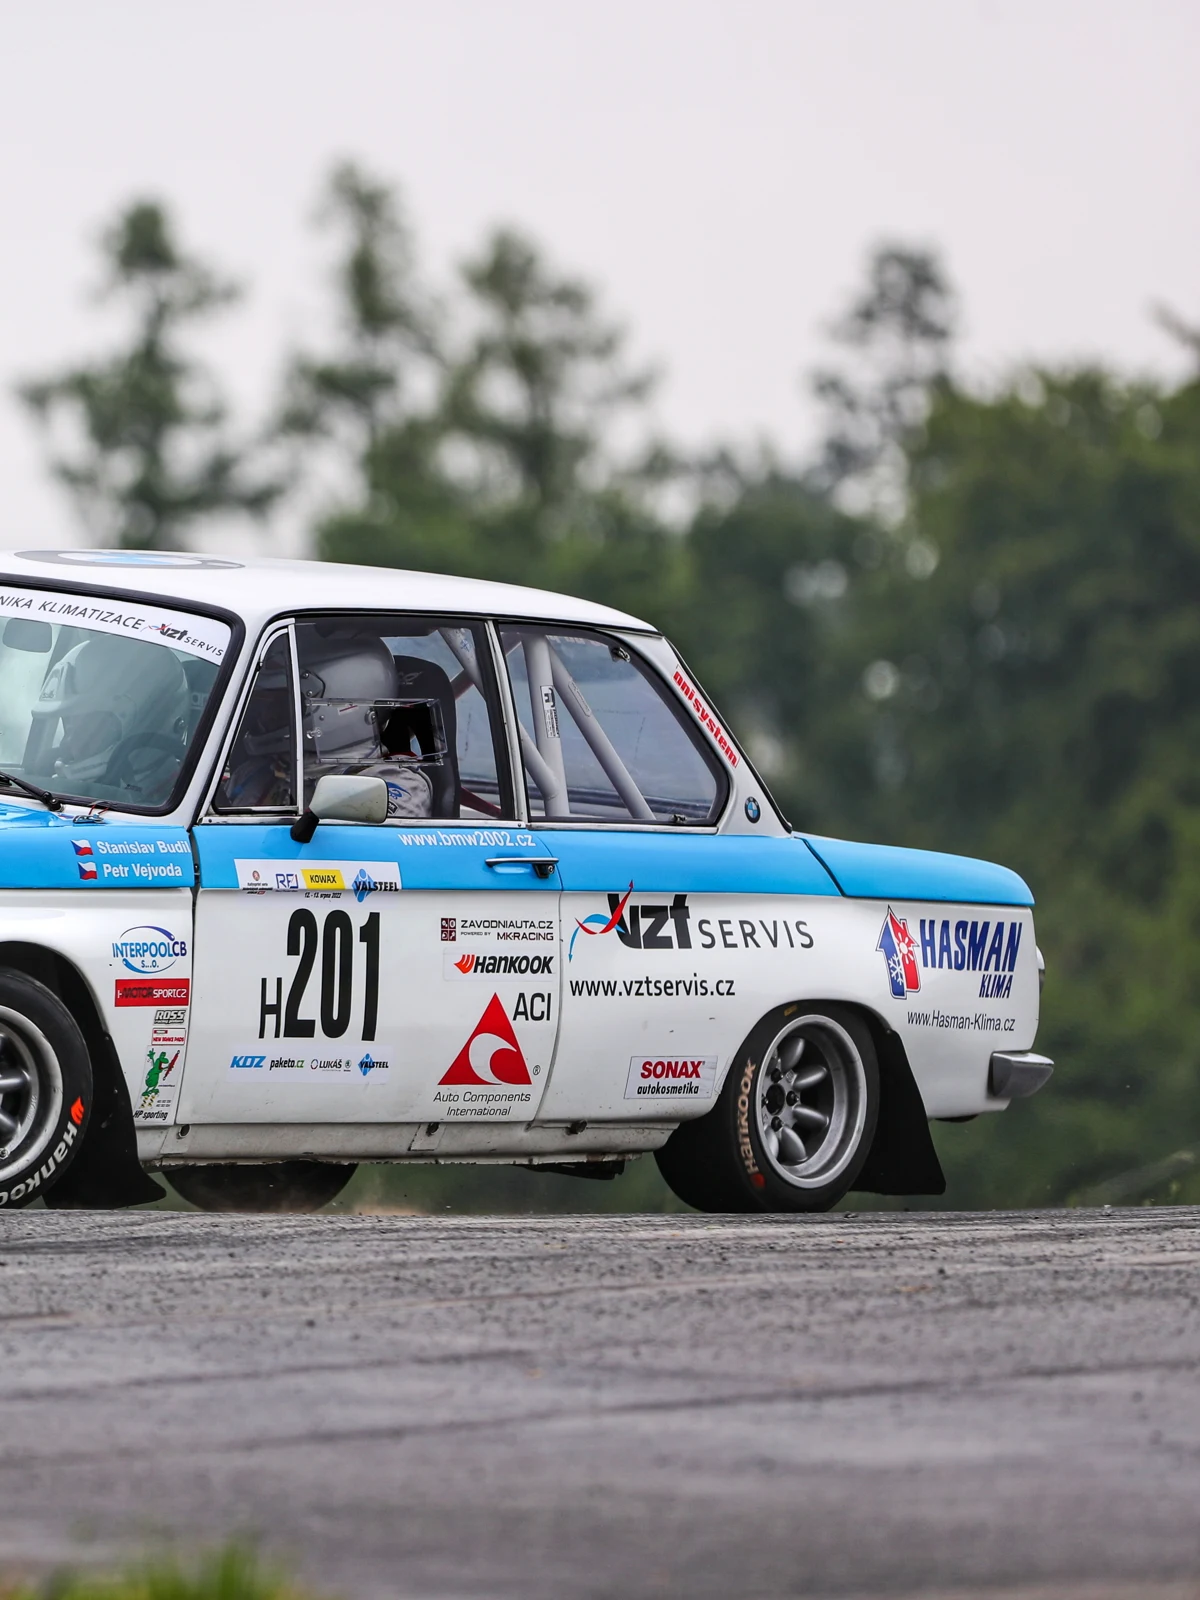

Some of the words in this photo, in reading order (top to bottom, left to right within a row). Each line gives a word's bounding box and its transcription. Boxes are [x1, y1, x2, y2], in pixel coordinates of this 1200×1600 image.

[38, 601, 146, 630] KLIMATIZACE
[184, 636, 225, 657] SERVIS
[398, 831, 536, 847] www.bmw2002.cz
[96, 840, 155, 855] Stanislav
[103, 863, 129, 877] Petr
[131, 863, 183, 880] Vejvoda
[309, 874, 337, 884] KOWAX
[354, 880, 400, 892] VALSTEEL
[460, 919, 554, 929] ZAVODNIAUTA.CZ
[699, 919, 814, 949] SERVIS
[919, 919, 1023, 973] HASMAN
[570, 973, 735, 996] www.vztservis.cz
[979, 974, 1013, 998] KLIMA
[512, 992, 551, 1021] ACI
[155, 1010, 186, 1020] ROSS
[907, 1010, 1015, 1032] www.Hasman-Klima.cz
[269, 1057, 305, 1070] paketo.cz
[319, 1058, 342, 1069] LUKÁŠ
[640, 1060, 703, 1079] SONAX
[637, 1081, 699, 1095] autokosmetika
[433, 1091, 459, 1102] Auto
[462, 1091, 531, 1104] Components
[142, 1110, 168, 1120] sporting
[446, 1105, 512, 1117] International
